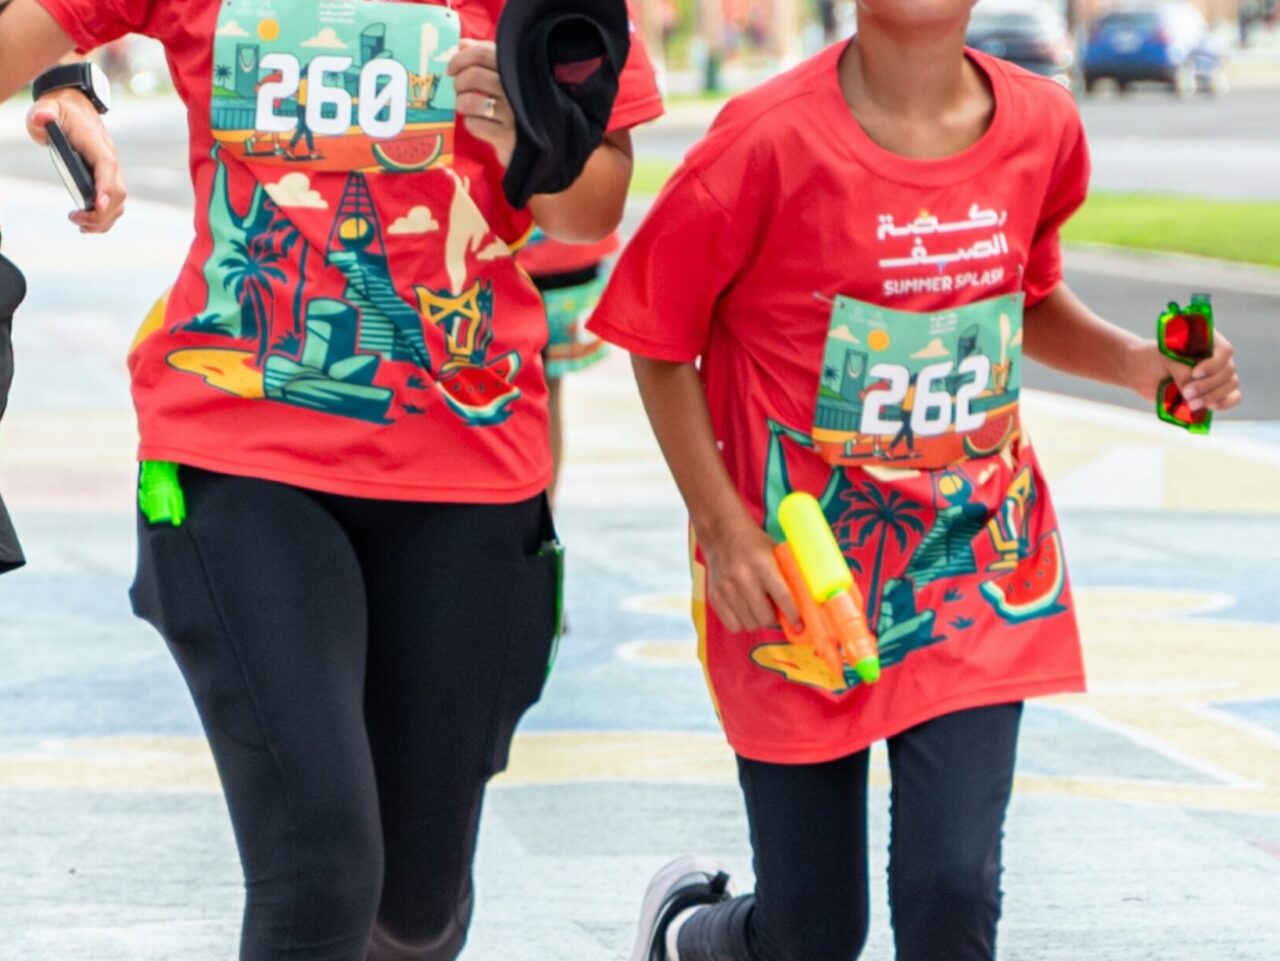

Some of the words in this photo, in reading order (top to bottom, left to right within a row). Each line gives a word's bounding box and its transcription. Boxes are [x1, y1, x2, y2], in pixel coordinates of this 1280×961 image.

[254, 53, 408, 138] 260
[883, 275, 952, 296] SUMMER
[860, 354, 990, 436] 262
